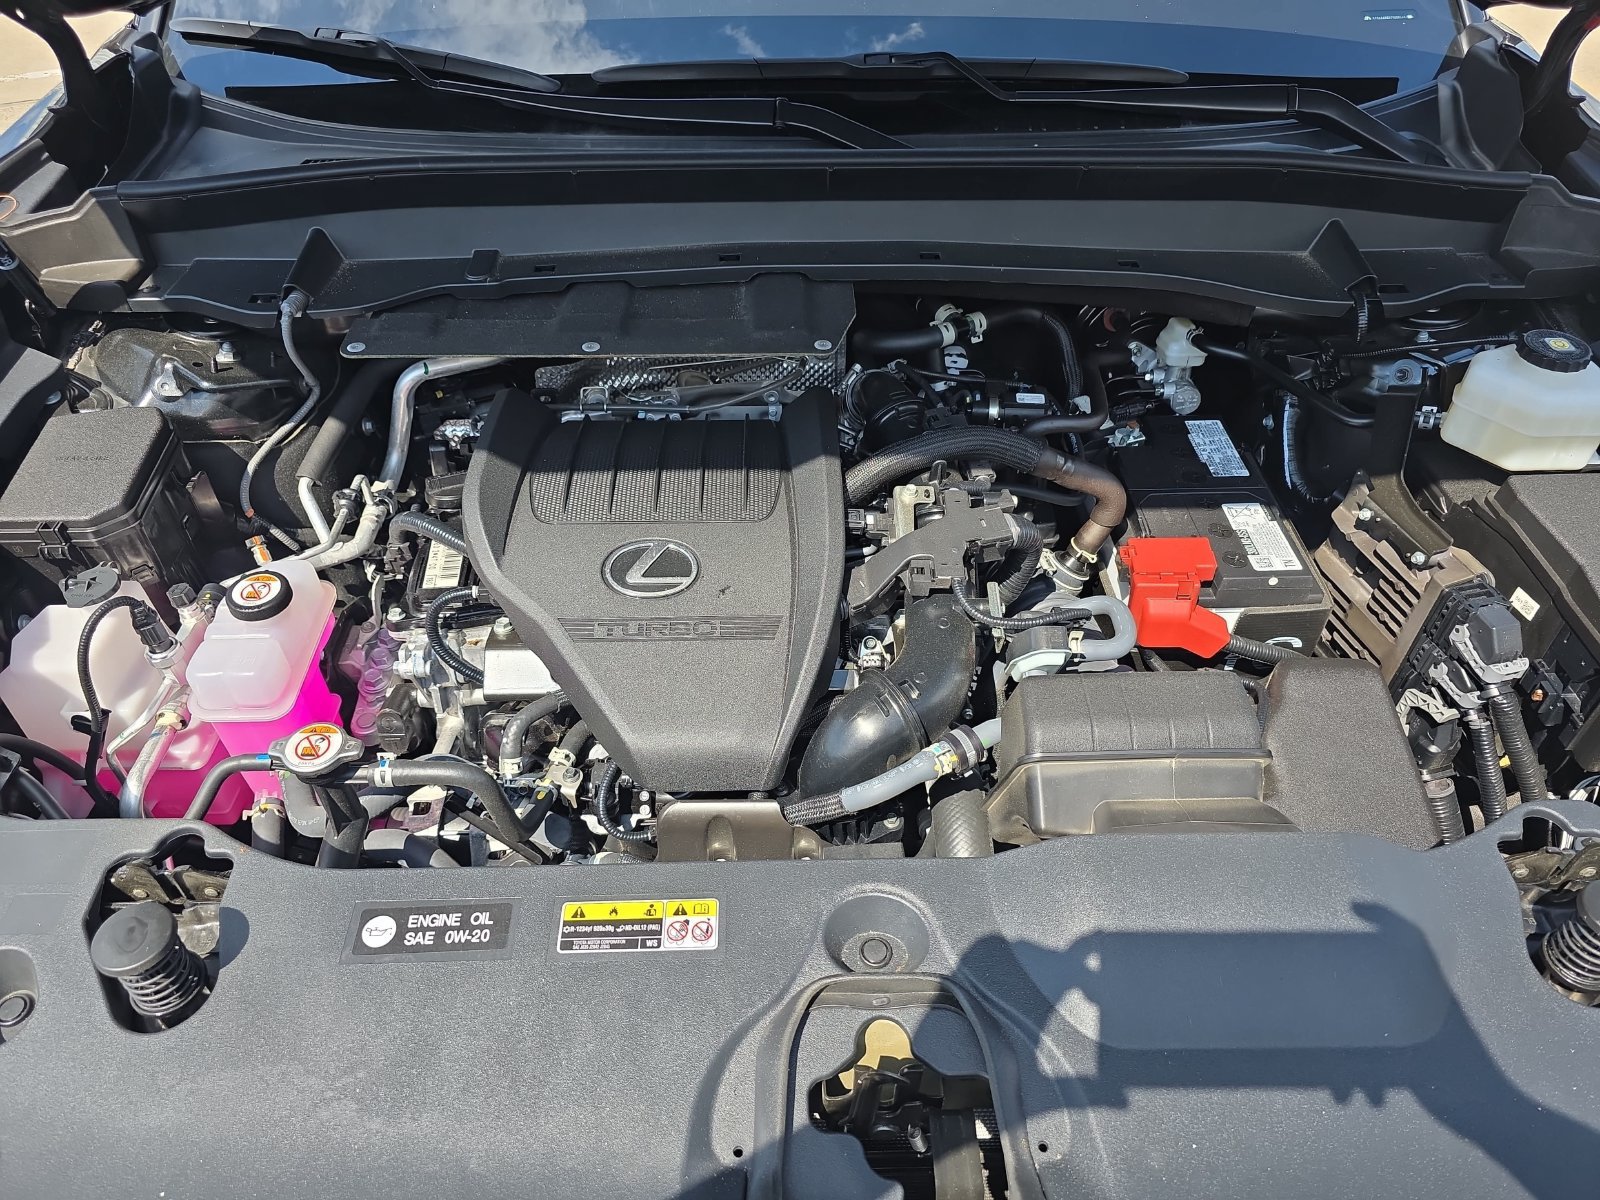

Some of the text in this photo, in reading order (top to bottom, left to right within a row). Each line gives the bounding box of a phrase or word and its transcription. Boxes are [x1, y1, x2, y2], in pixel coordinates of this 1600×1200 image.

[595, 620, 721, 638] TURBO
[408, 912, 494, 928] ENGINE OIL
[403, 929, 490, 946] SAE 0W-20
[646, 939, 658, 947] WS
